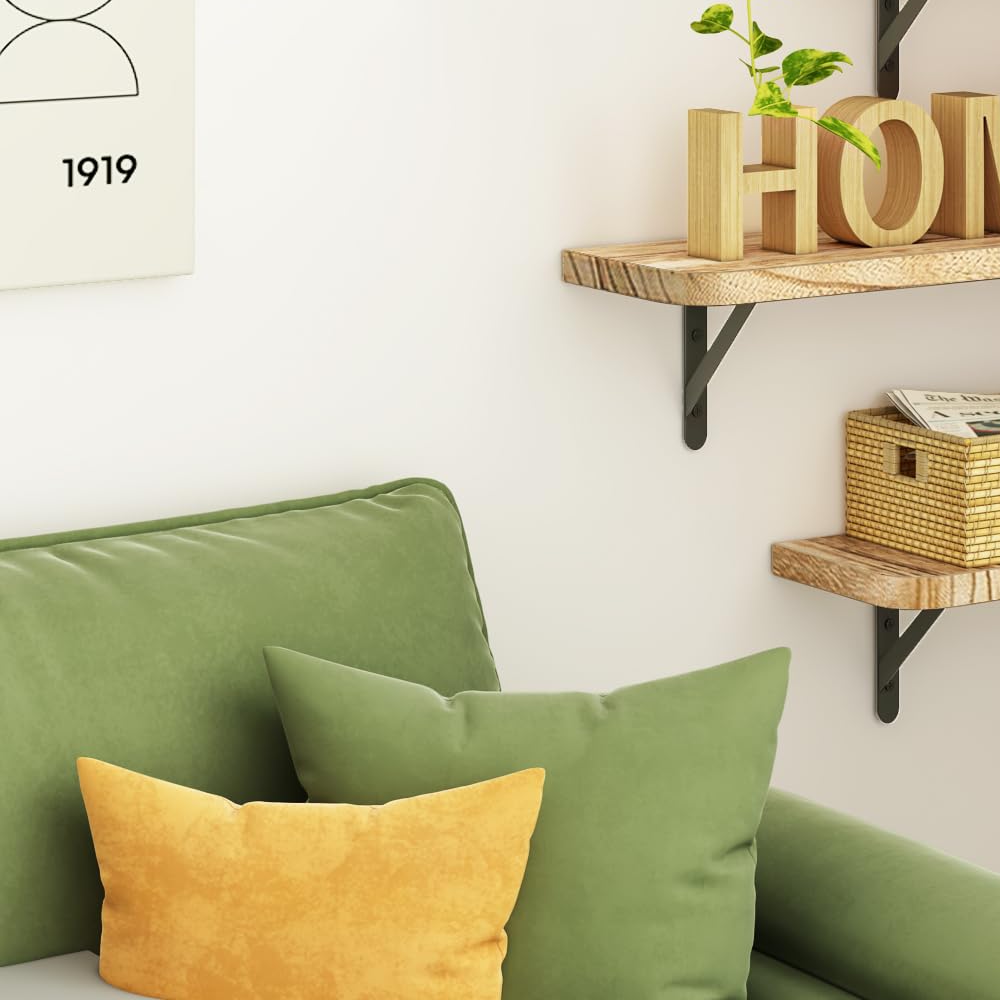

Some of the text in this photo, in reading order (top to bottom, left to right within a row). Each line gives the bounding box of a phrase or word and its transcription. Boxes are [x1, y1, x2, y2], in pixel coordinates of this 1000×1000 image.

[62, 154, 137, 187] 1919
[924, 394, 957, 402] The
[931, 410, 951, 419] A
